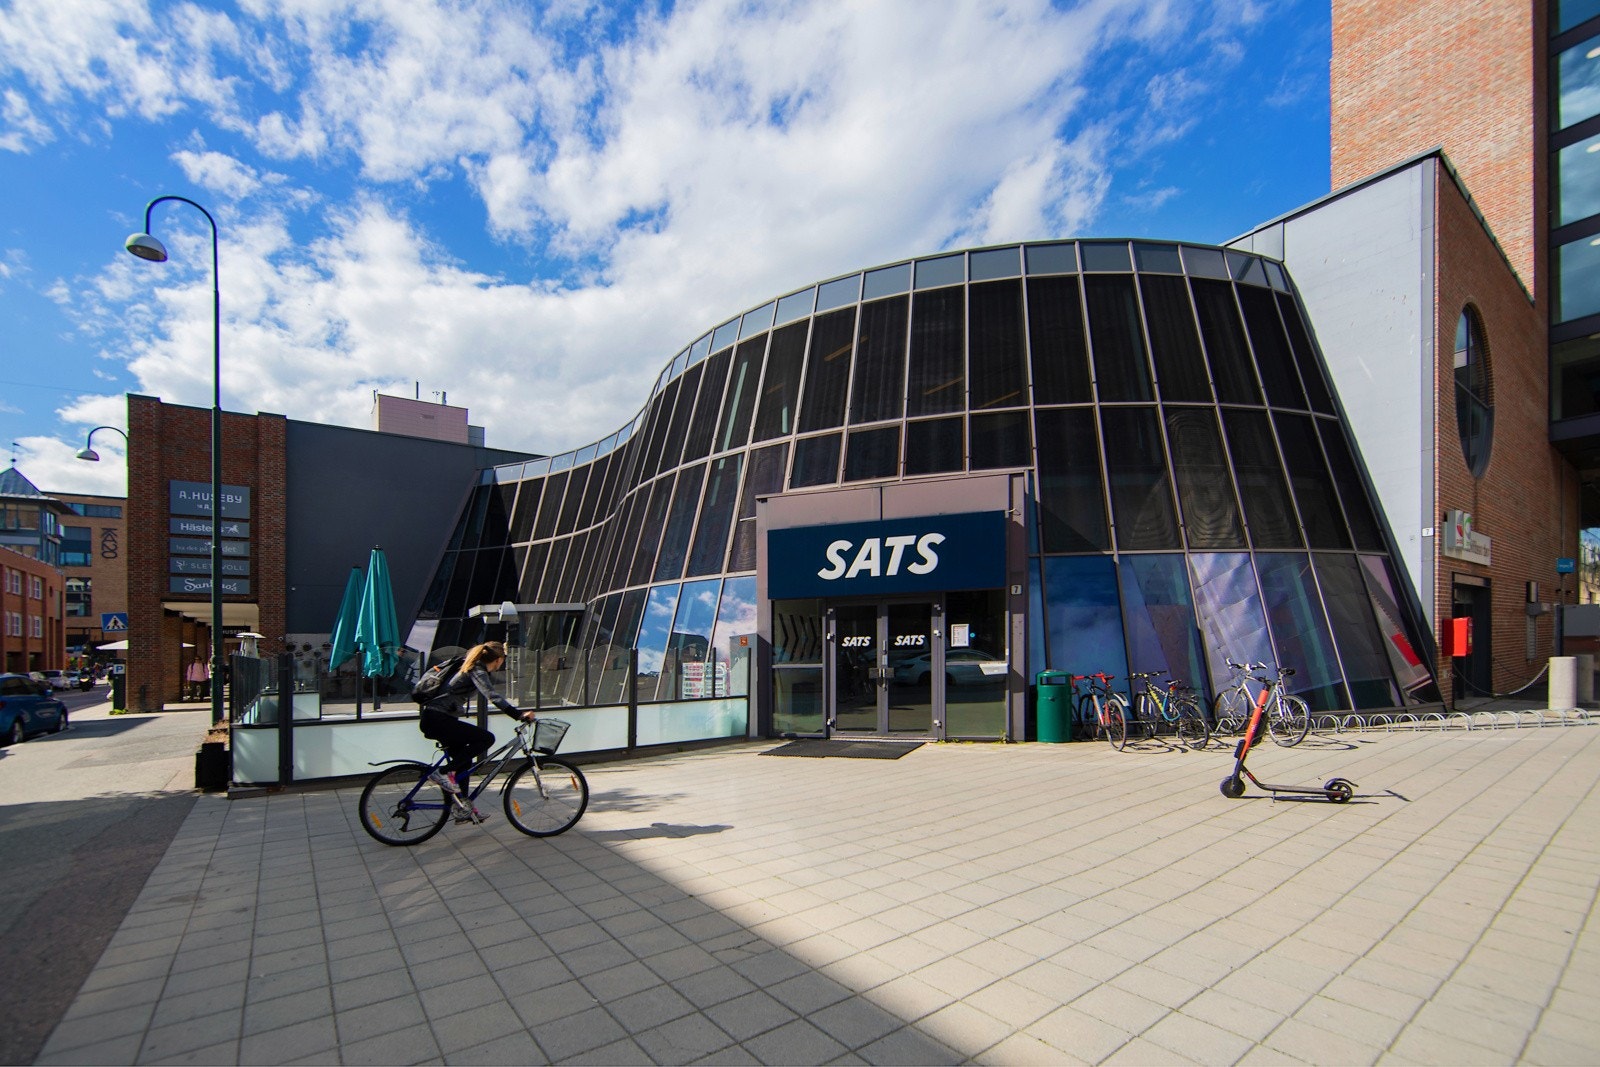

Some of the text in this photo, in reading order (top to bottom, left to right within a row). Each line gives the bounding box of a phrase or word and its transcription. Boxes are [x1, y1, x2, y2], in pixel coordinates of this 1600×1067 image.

[179, 490, 242, 504] A.HUEBY
[817, 532, 946, 581] SATS
[1014, 585, 1019, 594] 7
[841, 634, 925, 647] SATS SATS
